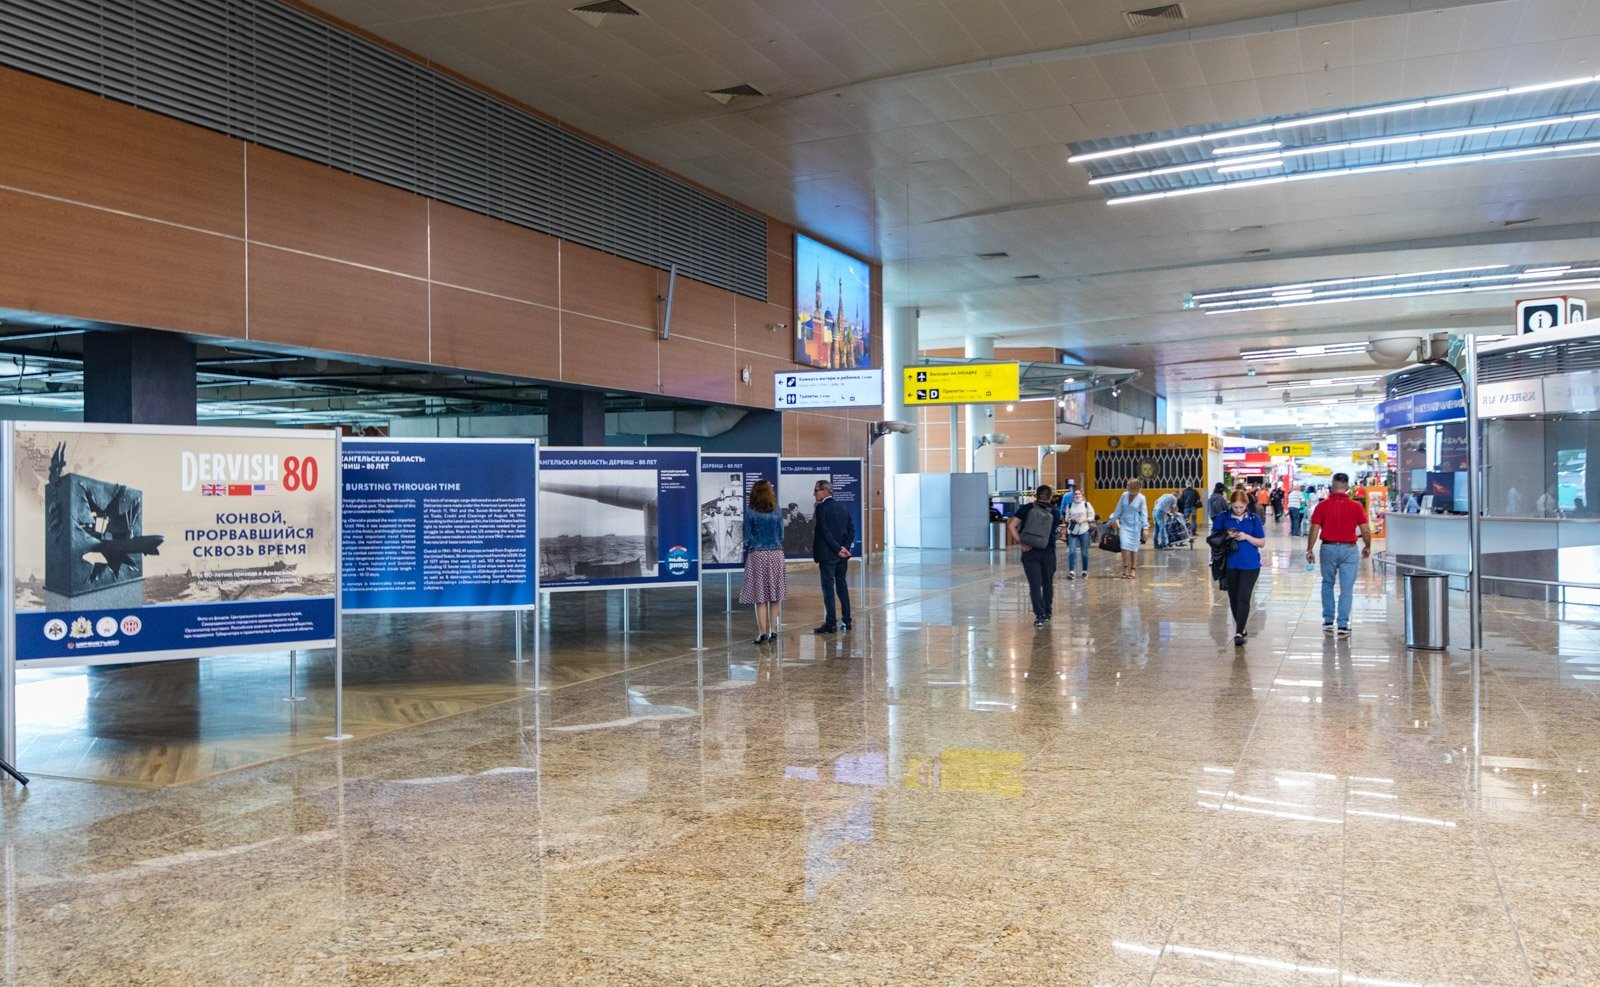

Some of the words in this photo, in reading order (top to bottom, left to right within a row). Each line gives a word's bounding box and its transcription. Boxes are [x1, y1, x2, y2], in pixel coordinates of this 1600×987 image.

[931, 390, 938, 398] D
[182, 451, 279, 492] DERVISH
[283, 456, 318, 491] 80
[346, 483, 391, 492] BURSTING
[392, 483, 437, 492] THROUGH
[440, 483, 461, 492] TIME
[216, 510, 286, 525] КОНВОЙ,
[185, 526, 314, 541] ПРОРВАВШИЙСЯ
[193, 546, 254, 557] СКВОЗЬ
[258, 544, 306, 556] ВРЕМЯ
